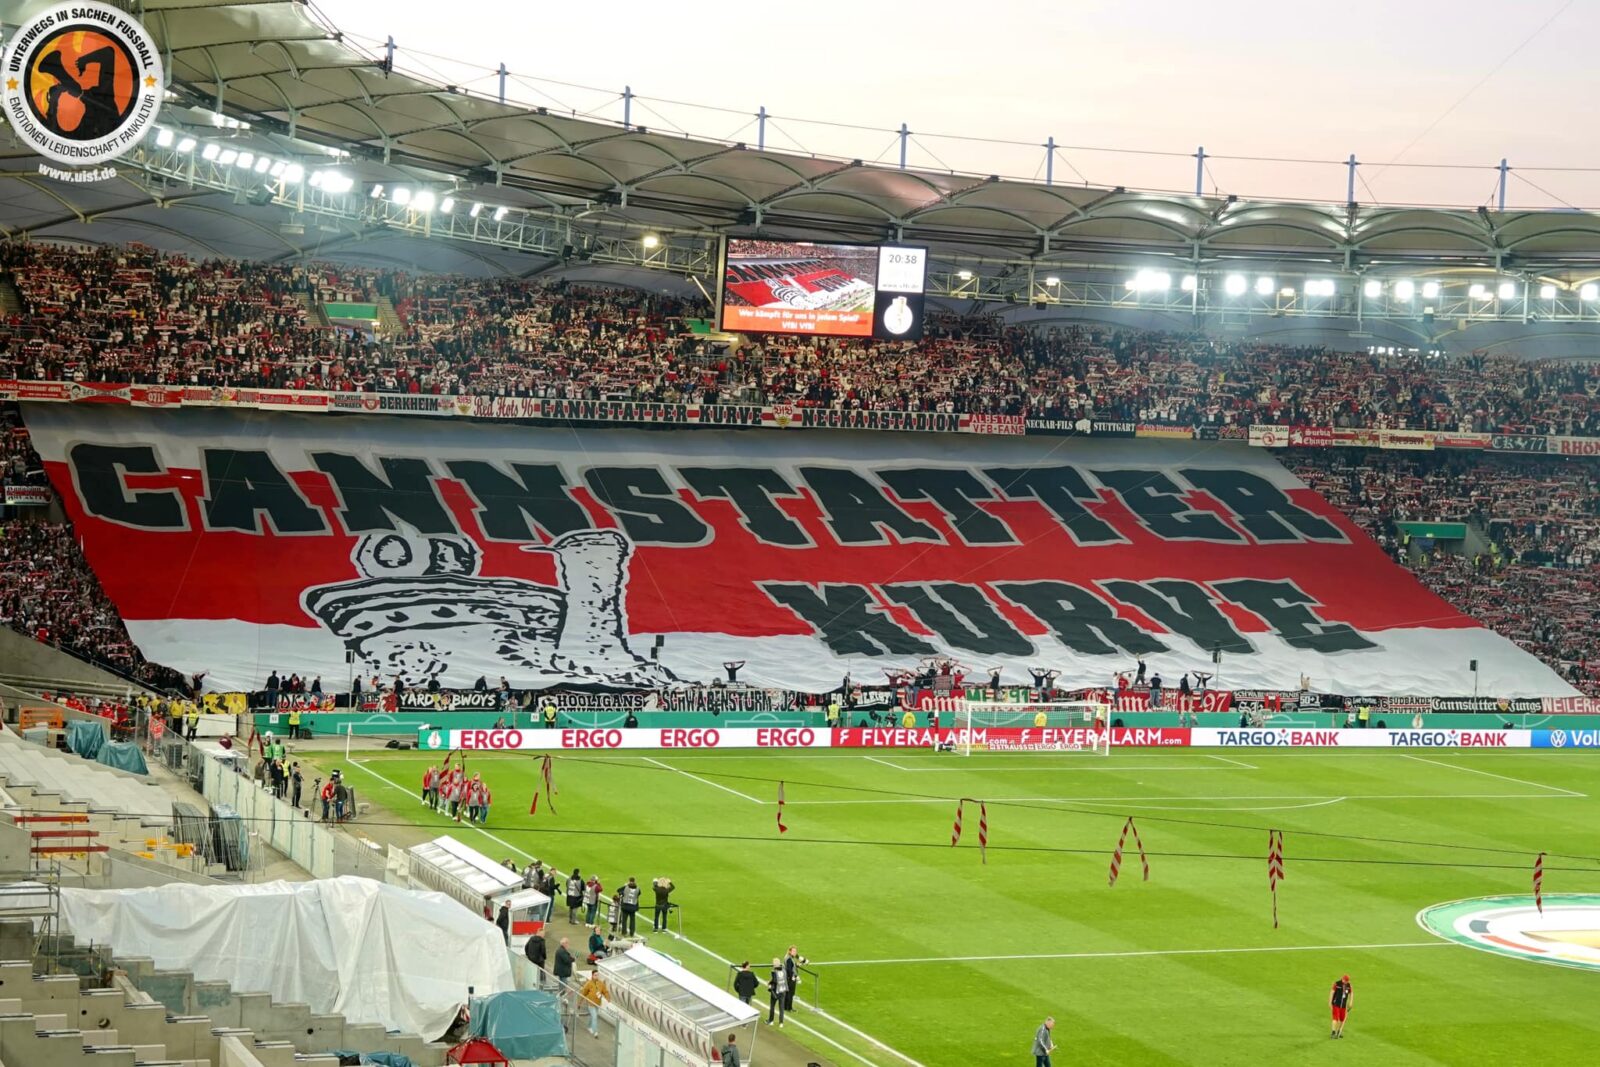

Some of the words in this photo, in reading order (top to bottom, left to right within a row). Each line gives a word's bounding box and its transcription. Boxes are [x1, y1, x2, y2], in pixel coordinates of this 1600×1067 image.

[889, 253, 917, 265] 20:38
[379, 396, 438, 411] BERKHEIM
[474, 396, 494, 416] Red
[521, 397, 533, 417] 96
[541, 400, 687, 423] CANNSTATTER
[700, 404, 762, 425] KURVE
[801, 408, 960, 432] NECKARSTADION
[970, 414, 1025, 424] ALBSTADT
[973, 424, 1025, 435] VFB-FANS
[1025, 419, 1073, 431] NECKAR-FILS
[1093, 421, 1136, 432] STUTTGART
[66, 441, 1352, 549] CANNSTATTER
[752, 578, 1386, 659] KURVE
[399, 693, 435, 707] YARD
[452, 694, 496, 707] BWOYS
[557, 694, 643, 708] HOOLIGANS
[1203, 691, 1229, 712] 97
[1431, 698, 1498, 712] Cannstatter
[1508, 699, 1542, 714] Jungs
[1541, 697, 1600, 713] WEILERic
[460, 729, 523, 749] ERGO
[562, 729, 623, 748] ERGO
[660, 728, 720, 747] ERGO
[756, 728, 815, 747] ERGO
[1571, 730, 1600, 746] Vol
